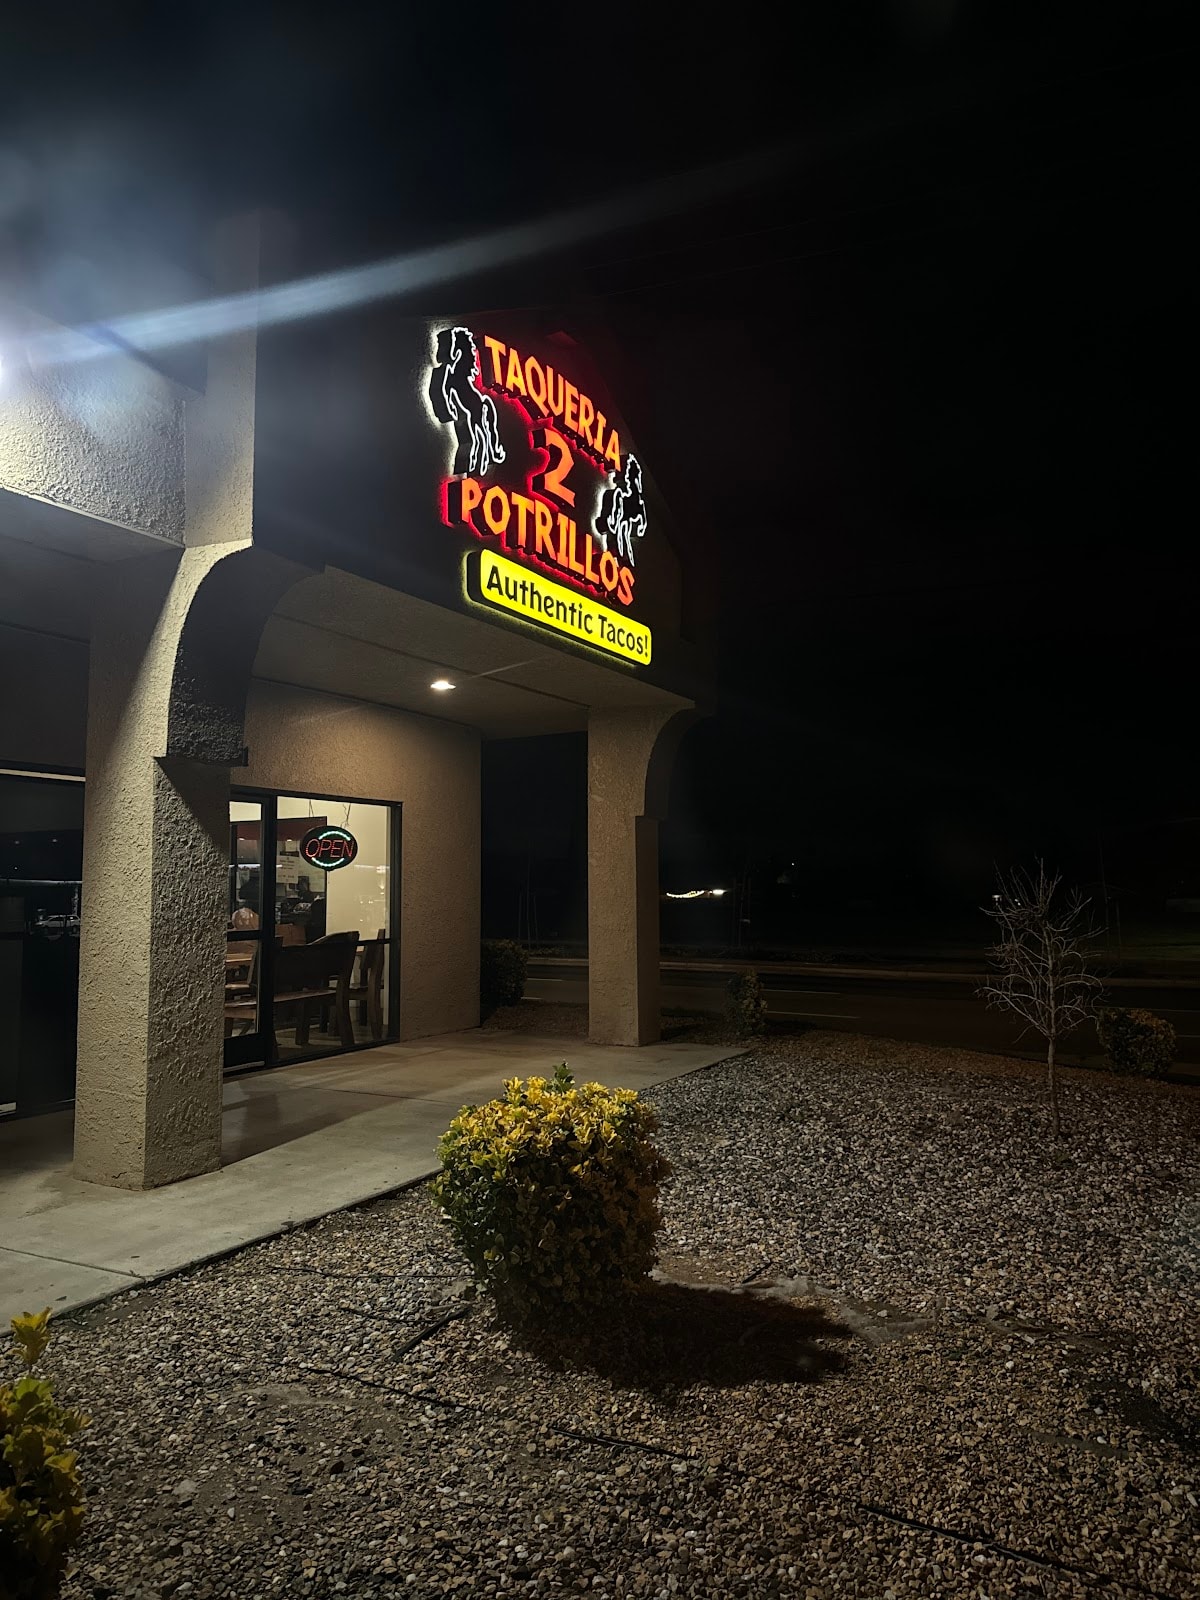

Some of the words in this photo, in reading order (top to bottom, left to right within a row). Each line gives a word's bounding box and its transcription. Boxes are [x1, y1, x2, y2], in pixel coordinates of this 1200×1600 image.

[484, 335, 620, 470] TAQUERIA
[545, 431, 575, 507] 2
[462, 478, 634, 606] POTRILLOS
[486, 565, 593, 635] Authentic
[598, 614, 649, 656] Tacos!
[306, 839, 353, 857] OPEN
